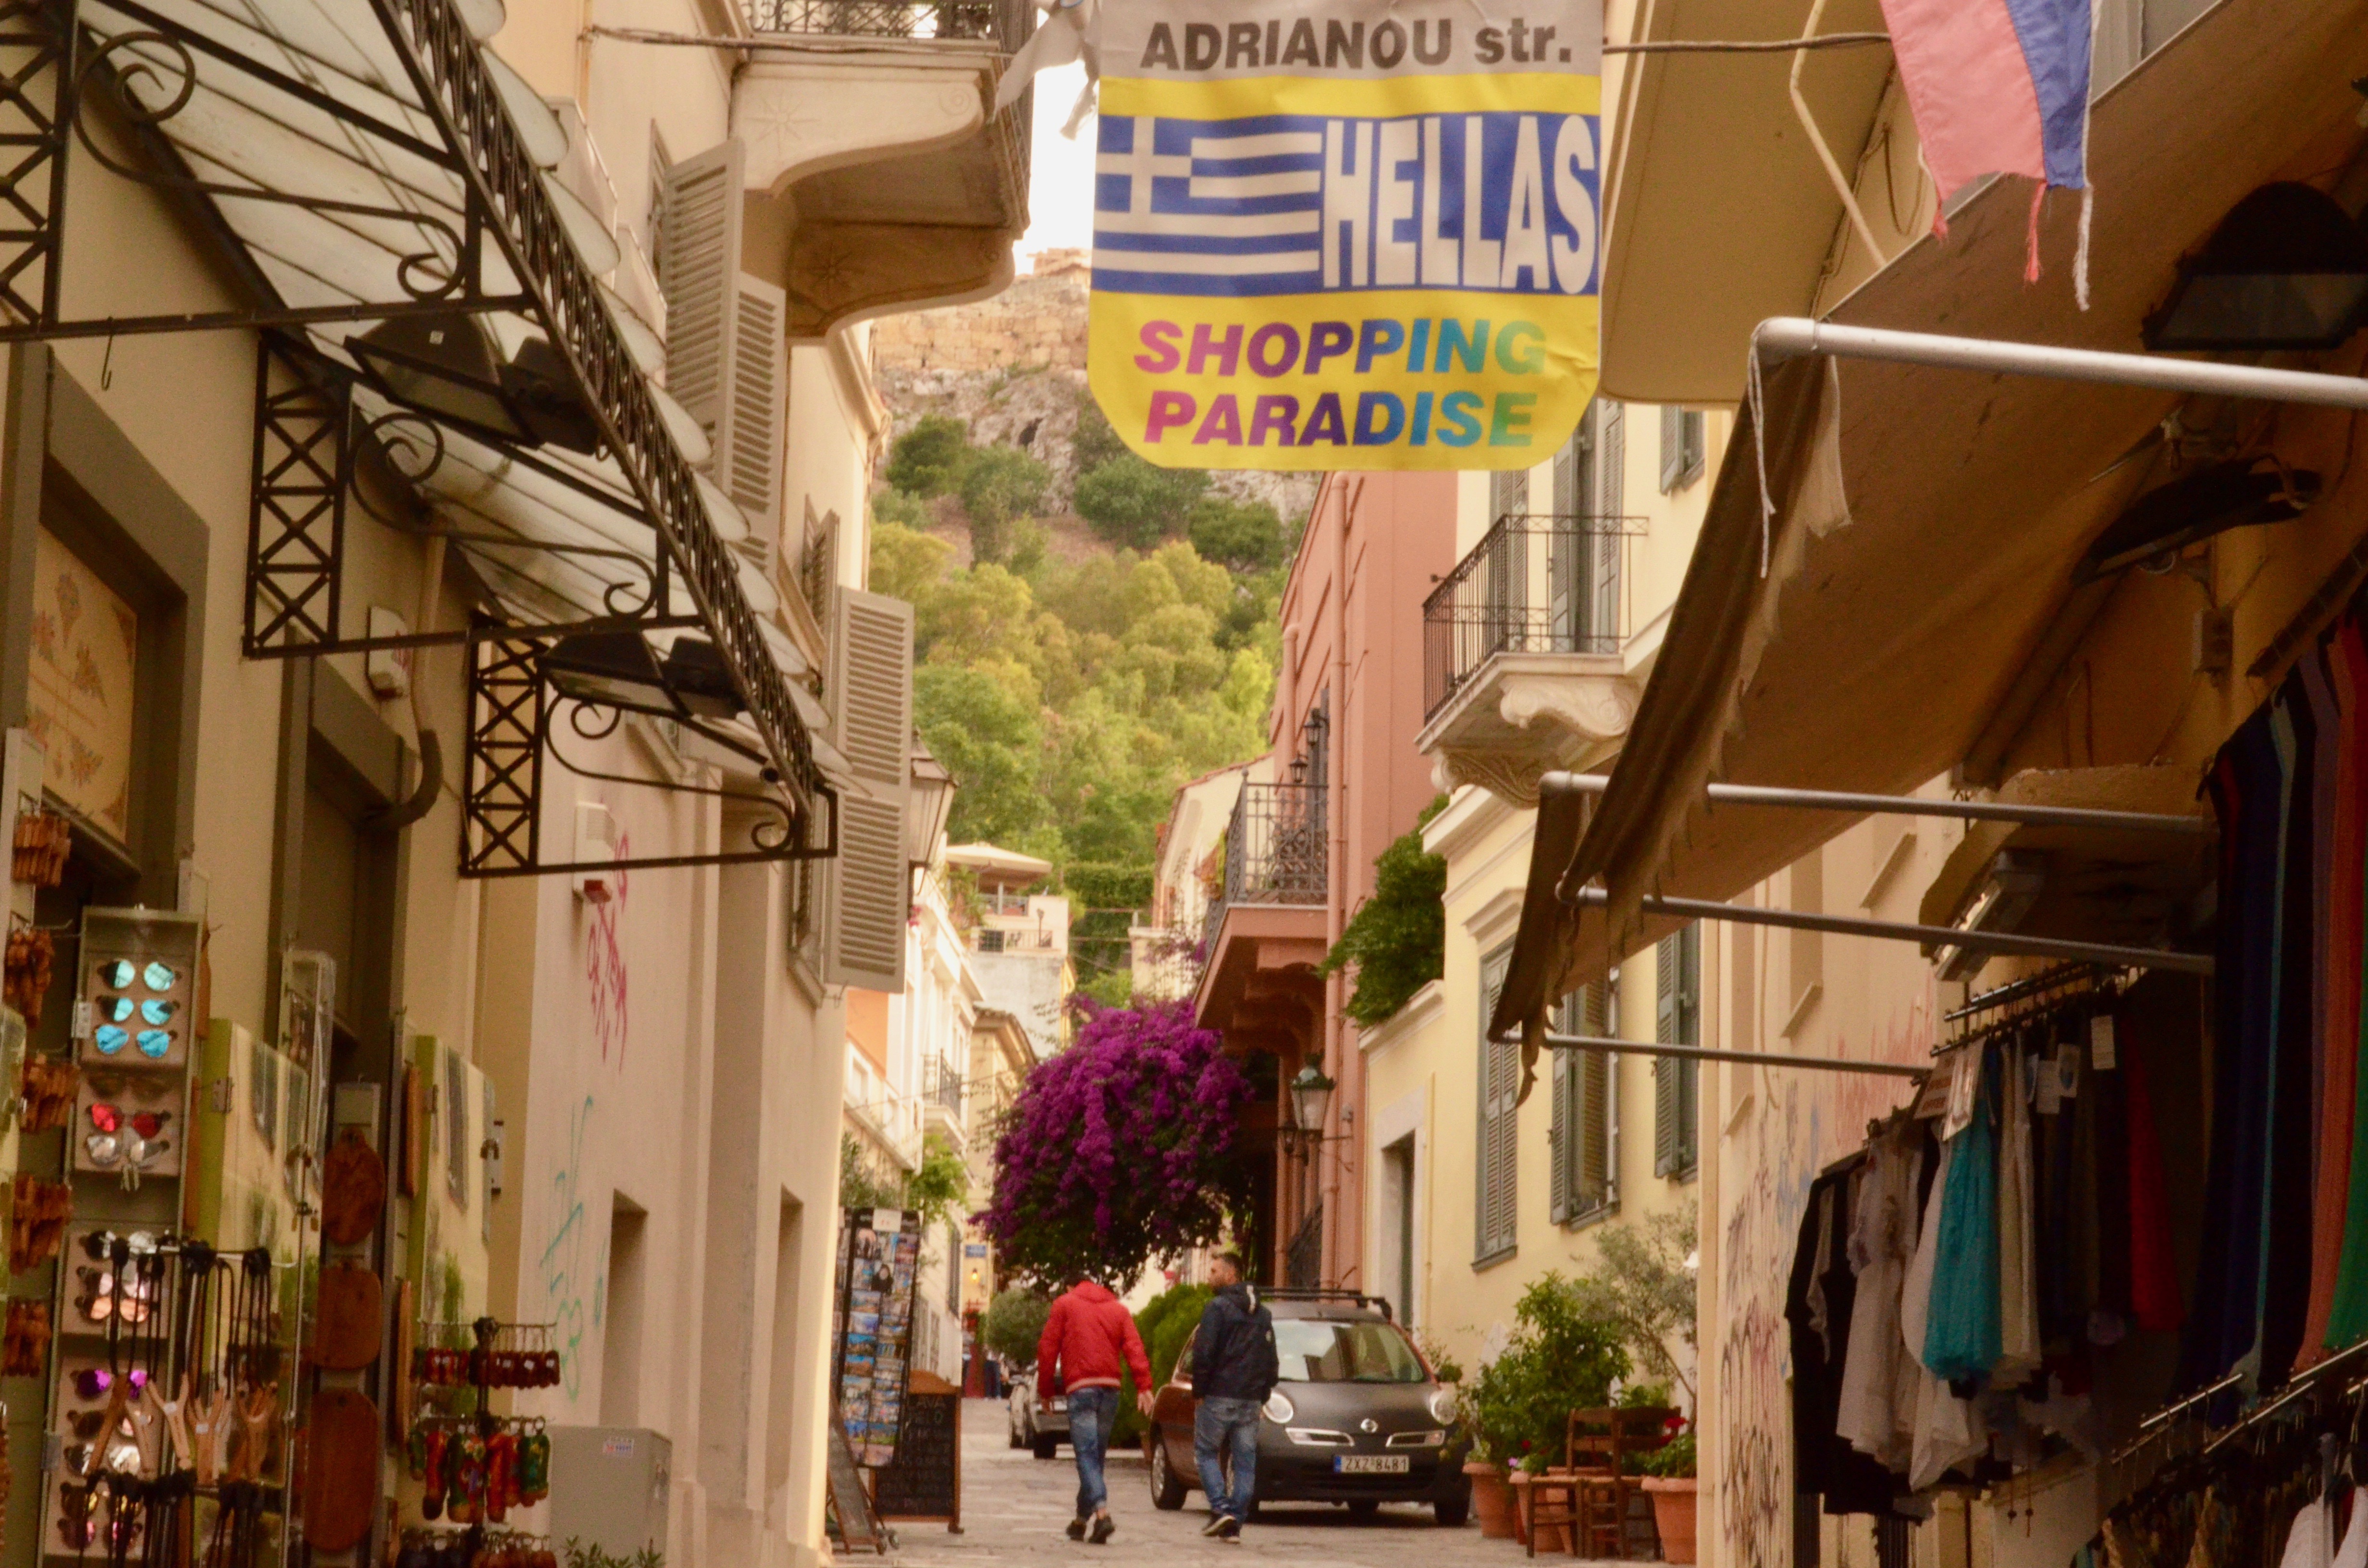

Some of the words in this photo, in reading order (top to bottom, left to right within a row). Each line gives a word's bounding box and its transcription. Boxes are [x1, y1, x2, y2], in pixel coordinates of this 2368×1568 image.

[1140, 17, 1451, 71] ADRIANOU
[1474, 18, 1571, 65] str.
[1323, 114, 1596, 294] HELLAS
[1134, 318, 1546, 378] SHOPPING
[1143, 390, 1537, 447] PARADISE
